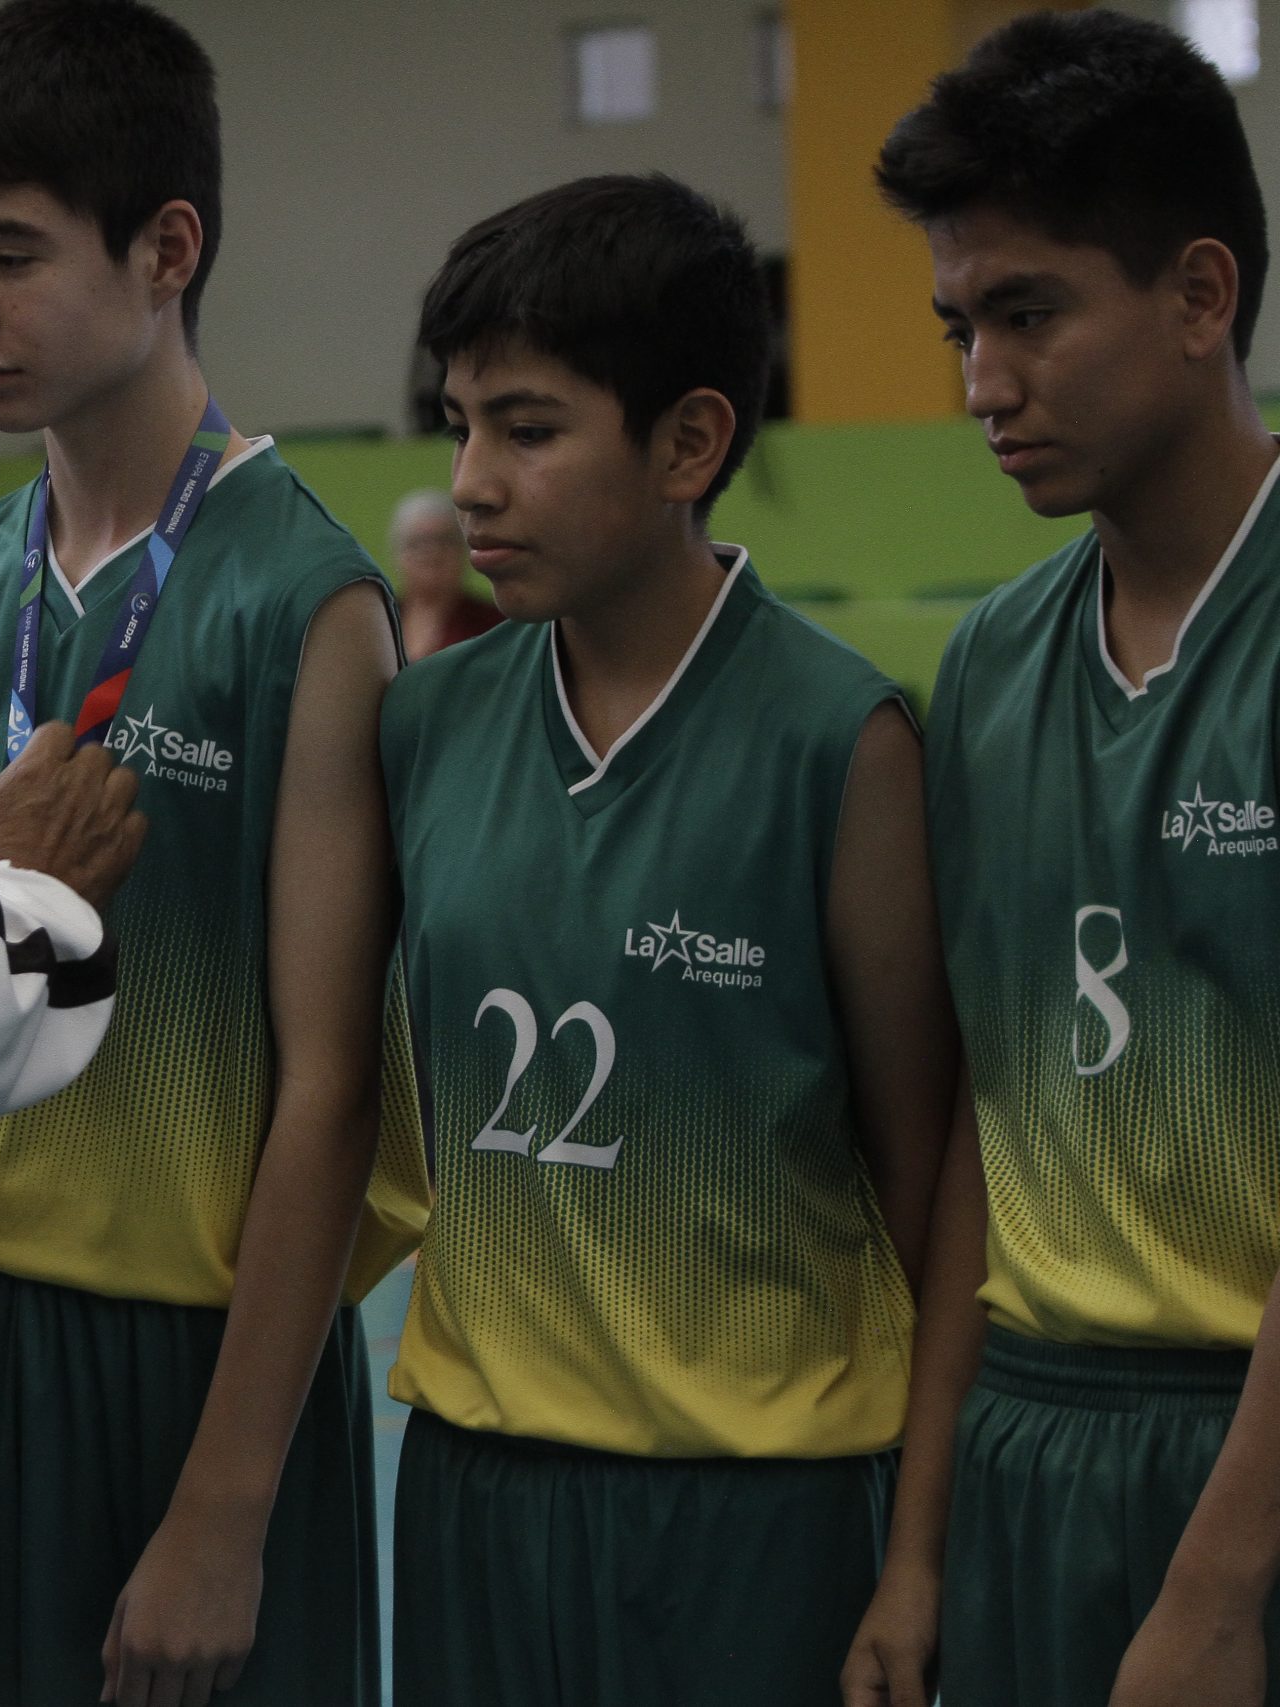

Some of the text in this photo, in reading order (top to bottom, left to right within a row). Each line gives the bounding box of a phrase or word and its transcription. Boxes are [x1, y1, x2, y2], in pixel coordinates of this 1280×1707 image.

[165, 452, 209, 534] ETAPA MACRO REGIONAL
[119, 614, 138, 649] JEDPA
[103, 721, 233, 771] La Salle
[145, 760, 228, 791] Arequipa
[1161, 800, 1275, 839] La Salle
[1207, 835, 1278, 857] Arequipa
[624, 928, 766, 967] La Salle
[681, 965, 762, 990] Arequipa
[1073, 905, 1130, 1075] 8
[471, 988, 624, 1169] 22
